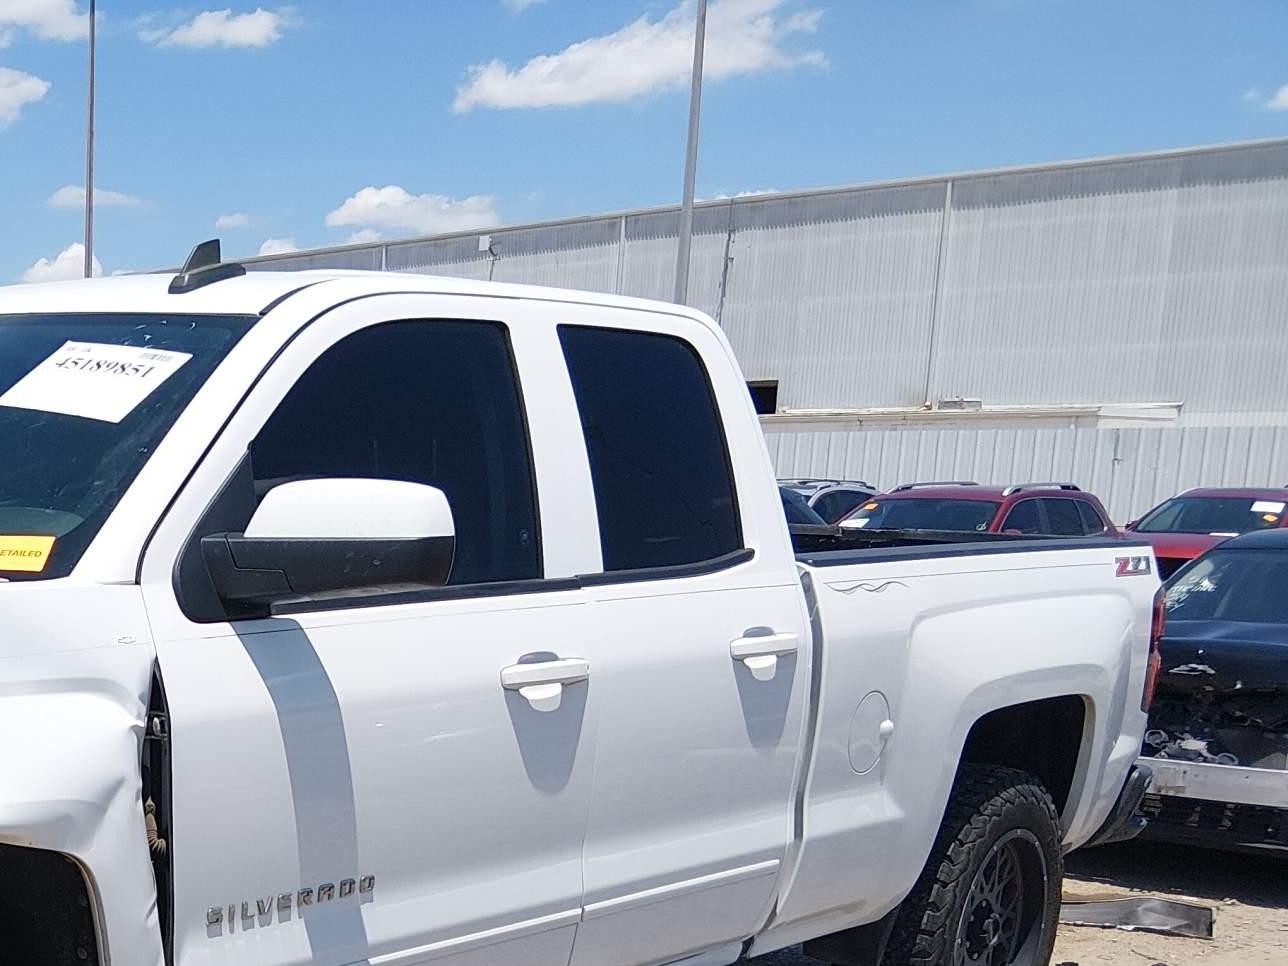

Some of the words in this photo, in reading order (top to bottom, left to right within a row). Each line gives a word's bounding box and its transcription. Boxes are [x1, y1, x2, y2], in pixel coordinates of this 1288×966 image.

[55, 356, 155, 378] 45189851
[1115, 556, 1152, 577] Z71
[206, 873, 376, 927] SILVERADO
